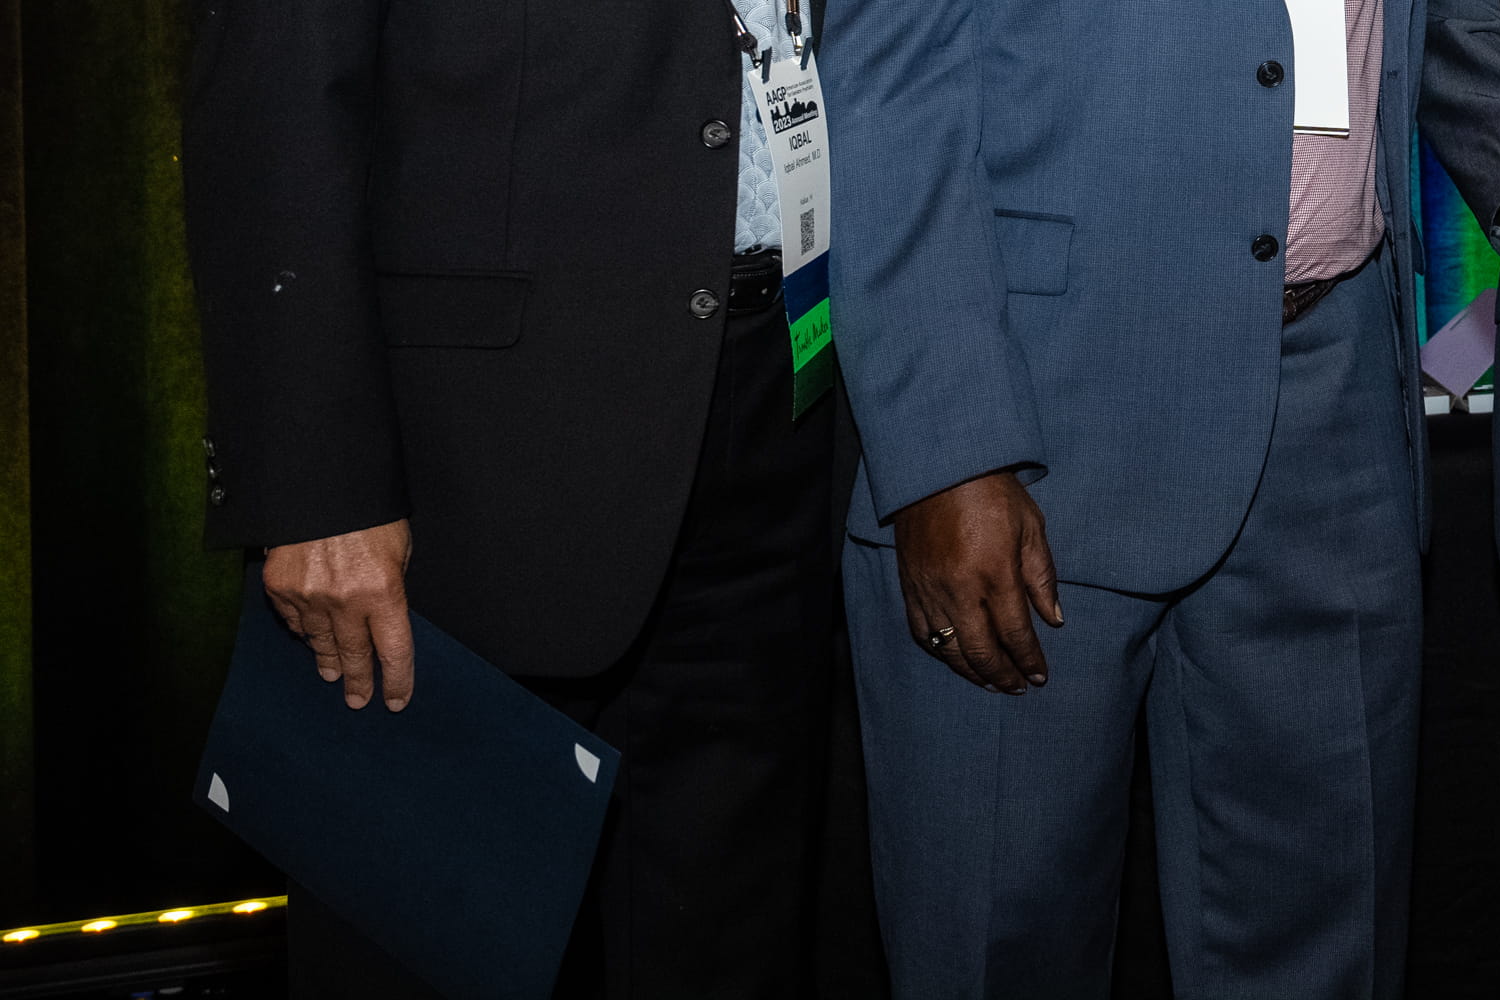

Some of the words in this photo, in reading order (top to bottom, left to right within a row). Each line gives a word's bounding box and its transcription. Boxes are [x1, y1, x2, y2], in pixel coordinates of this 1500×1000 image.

[766, 86, 787, 106] AAGP
[774, 115, 792, 132] 2023
[788, 130, 812, 151] IQBAL
